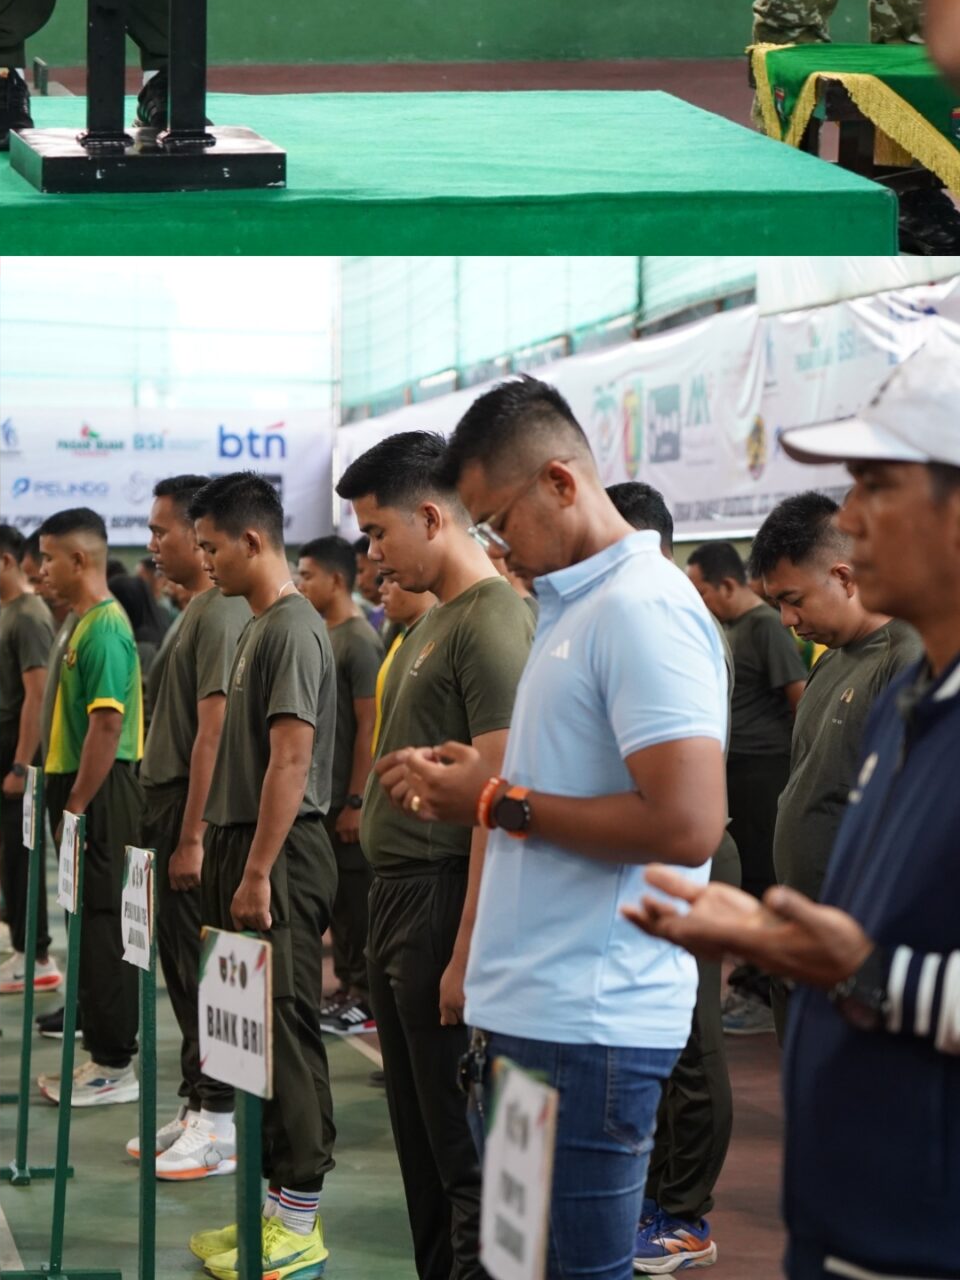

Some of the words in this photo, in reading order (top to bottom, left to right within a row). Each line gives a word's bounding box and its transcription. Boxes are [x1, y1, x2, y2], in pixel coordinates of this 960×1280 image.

[218, 424, 286, 459] btn
[207, 1004, 238, 1048] BANK
[242, 1016, 263, 1056] BRI
